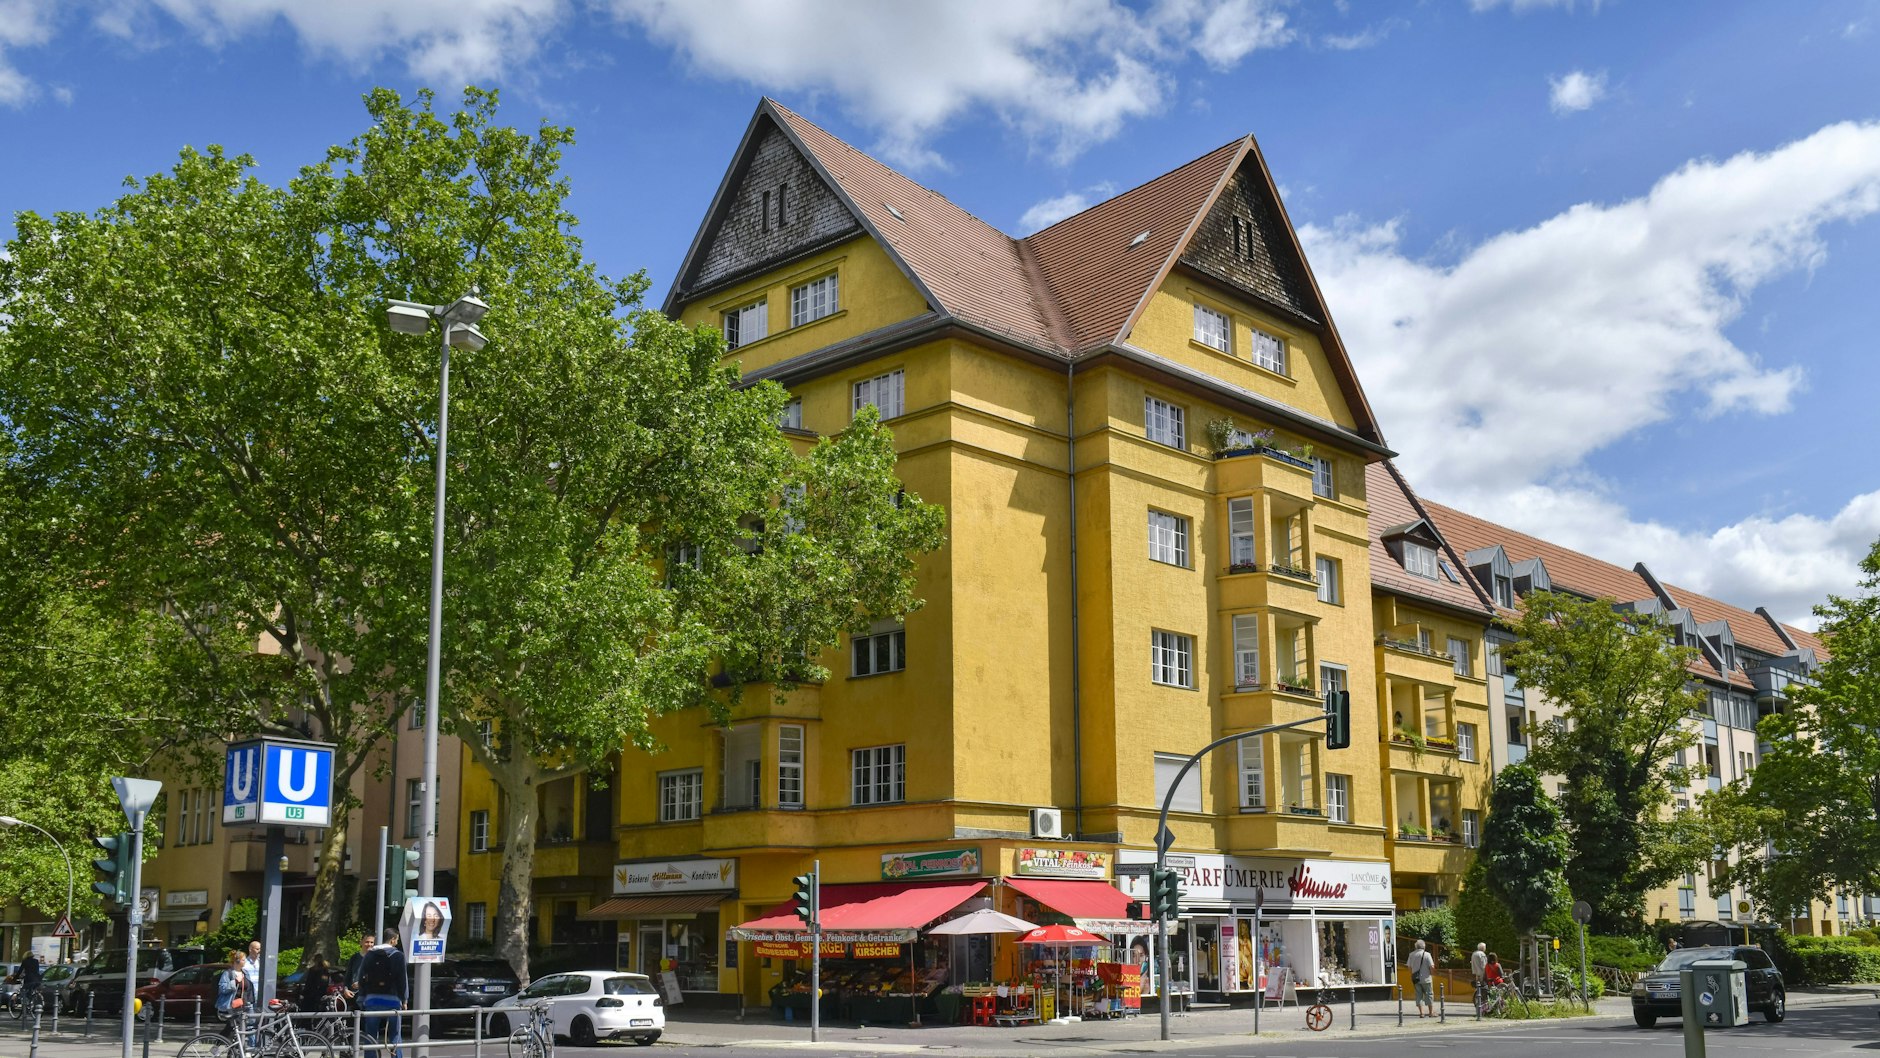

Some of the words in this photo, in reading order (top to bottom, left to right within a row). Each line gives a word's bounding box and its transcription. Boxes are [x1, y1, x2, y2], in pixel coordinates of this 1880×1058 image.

[232, 749, 254, 801] U
[278, 749, 318, 802] U
[287, 808, 303, 819] U3
[1033, 858, 1060, 868] VITAL
[628, 873, 650, 884] Bäckerei
[691, 869, 719, 881] Konditorei
[1182, 865, 1284, 889] PARFÜMERIE
[1351, 871, 1380, 883] LANCÔME
[743, 933, 774, 941] Frisches
[826, 933, 858, 942] Feinkost
[867, 933, 903, 942] Getränke
[1368, 930, 1379, 945] 80
[802, 942, 845, 954] SPRGEL
[855, 947, 899, 956] KIRSCHEN
